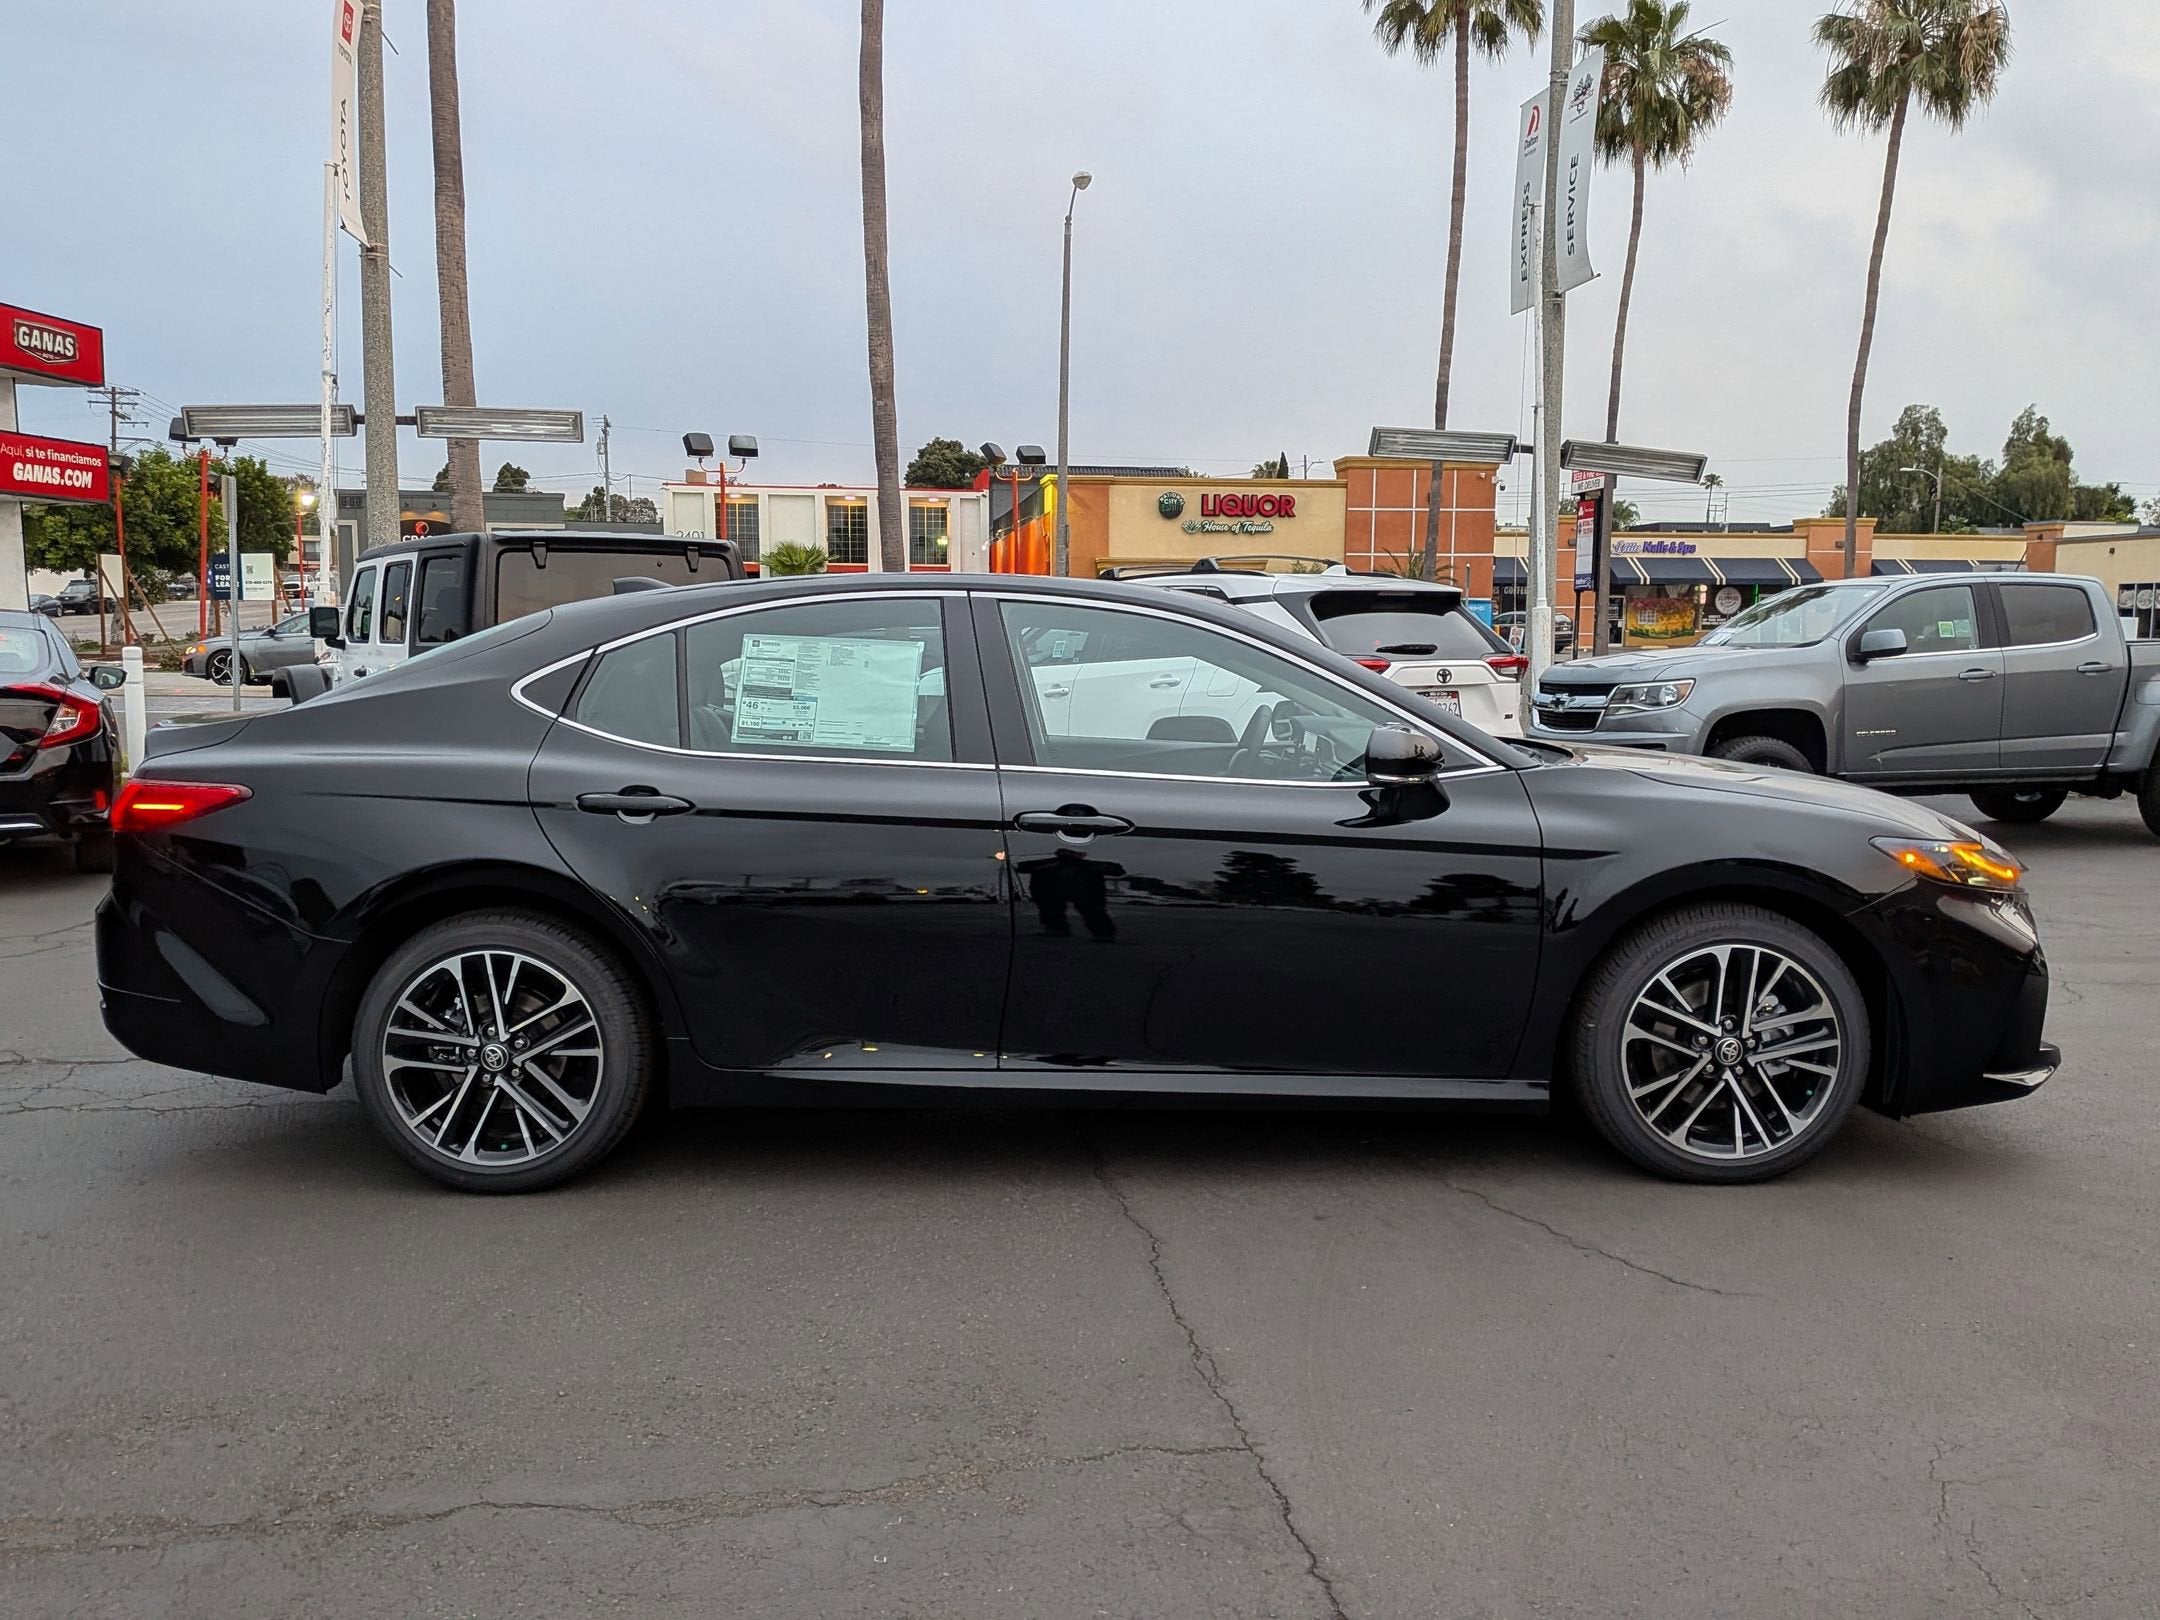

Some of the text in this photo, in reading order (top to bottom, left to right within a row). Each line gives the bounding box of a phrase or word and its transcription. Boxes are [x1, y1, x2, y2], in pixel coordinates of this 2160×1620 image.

[340, 98, 351, 202] TOYOTA
[1567, 153, 1579, 256] SERVICE
[1520, 181, 1531, 282] EXPRESS
[18, 326, 75, 357] GANAS
[35, 448, 46, 460] te
[47, 448, 102, 467] financiamos
[13, 461, 93, 489] GANAS.COM
[1201, 493, 1297, 518] LIQUOR
[1201, 520, 1275, 535] House of Tequila
[1643, 541, 1669, 554] Nails
[1678, 542, 1697, 555] Spa
[746, 701, 759, 710] 46
